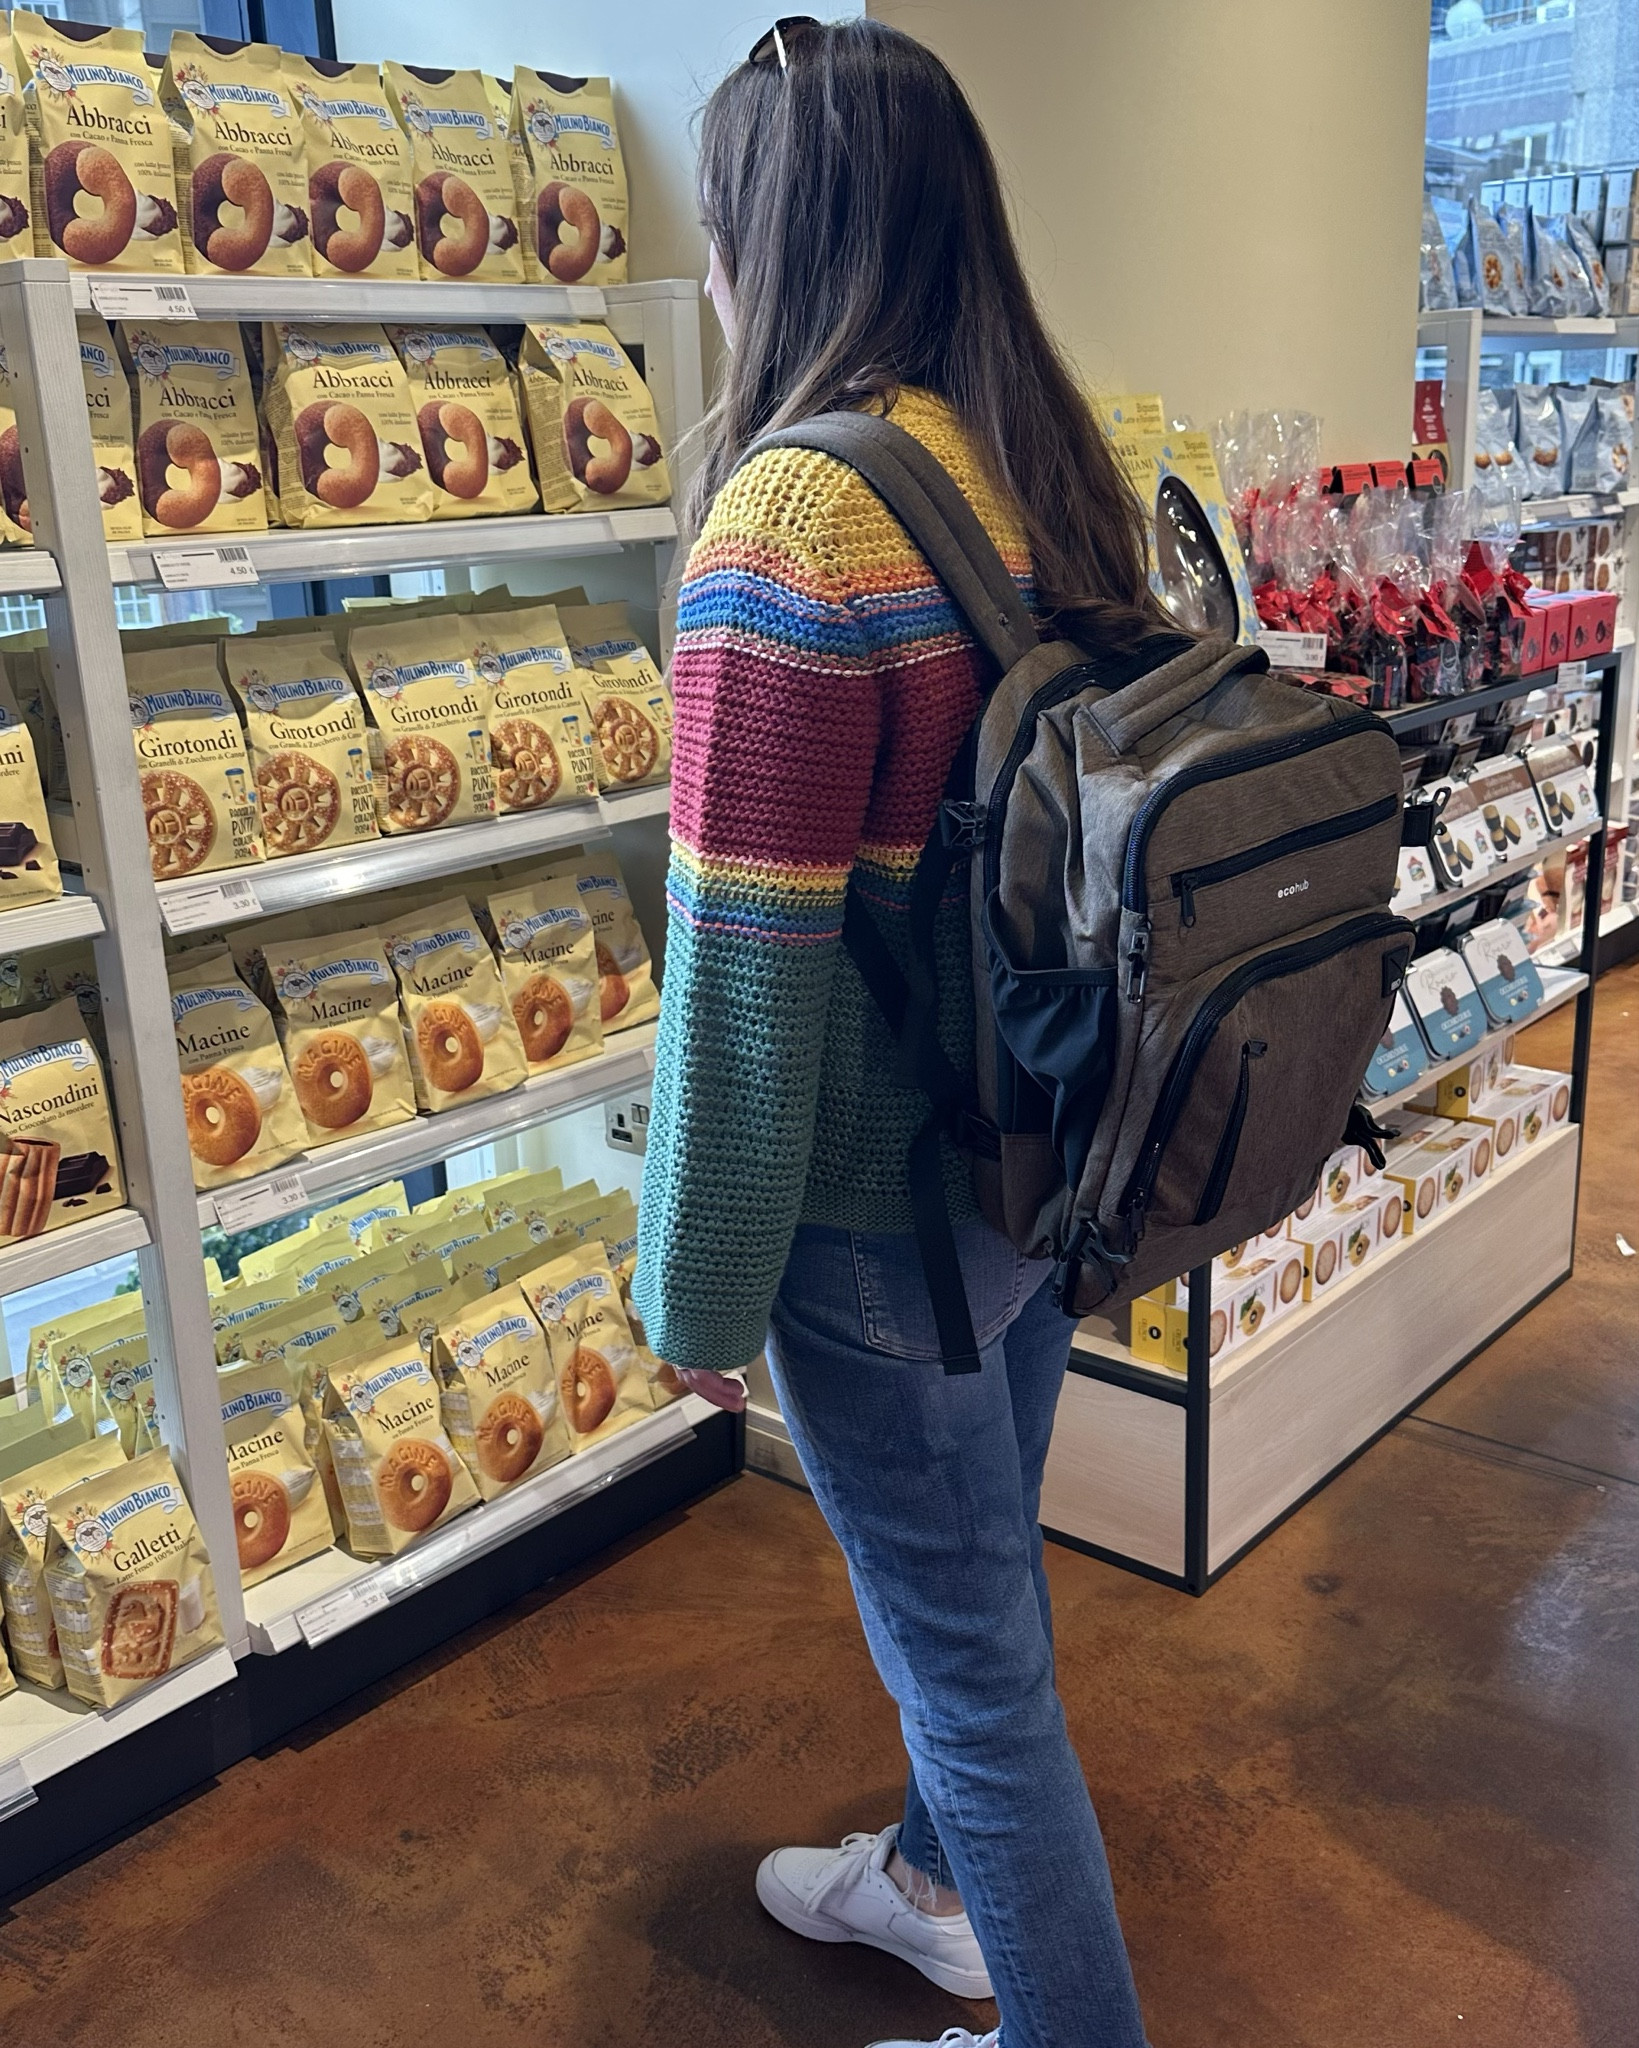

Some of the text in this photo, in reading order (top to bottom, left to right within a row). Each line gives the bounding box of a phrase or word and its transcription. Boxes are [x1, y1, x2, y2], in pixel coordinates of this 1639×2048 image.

[66, 105, 153, 135] Abbracci
[82, 131, 105, 141] Cacao
[129, 138, 153, 146] Fresca
[214, 121, 293, 146] Abbracci
[330, 131, 399, 157] Abbracci
[229, 145, 250, 153] Cacao
[431, 143, 495, 167] Abbracci
[551, 153, 614, 176] Abbracci
[80, 345, 105, 363] ANCO
[313, 370, 394, 389] Abbracci
[424, 369, 491, 391] Abbracci
[572, 370, 629, 392] Abbracci
[159, 387, 236, 410] Abbracci
[328, 391, 350, 399] Cacao
[376, 390, 395, 398] Fresca
[173, 410, 193, 418] Cacao
[213, 411, 237, 420] Fresca
[230, 567, 247, 575] 4.50
[593, 667, 653, 689] Girotondi
[494, 681, 573, 710] Girotondi
[390, 694, 479, 725] Girotondi
[269, 709, 357, 741] Girotondi
[138, 729, 238, 758] Girotondi
[184, 755, 217, 765] Zucchero
[224, 750, 246, 760] Canna
[1278, 880, 1309, 898] ecohub
[592, 908, 615, 926] cine
[522, 939, 575, 967] Macine
[413, 963, 475, 996] Macine
[310, 996, 372, 1023] Macine
[175, 1023, 251, 1056] Macine
[183, 1073, 241, 1103] ACINE
[0, 1077, 99, 1126] Nascondini
[65, 1101, 95, 1117] mordere
[221, 1401, 245, 1421] ULINO
[376, 1396, 435, 1434] Macine
[225, 1430, 285, 1464] Macine
[113, 1523, 182, 1572] Galletti
[134, 1561, 154, 1576] Fresco
[154, 1549, 174, 1563] 100%
